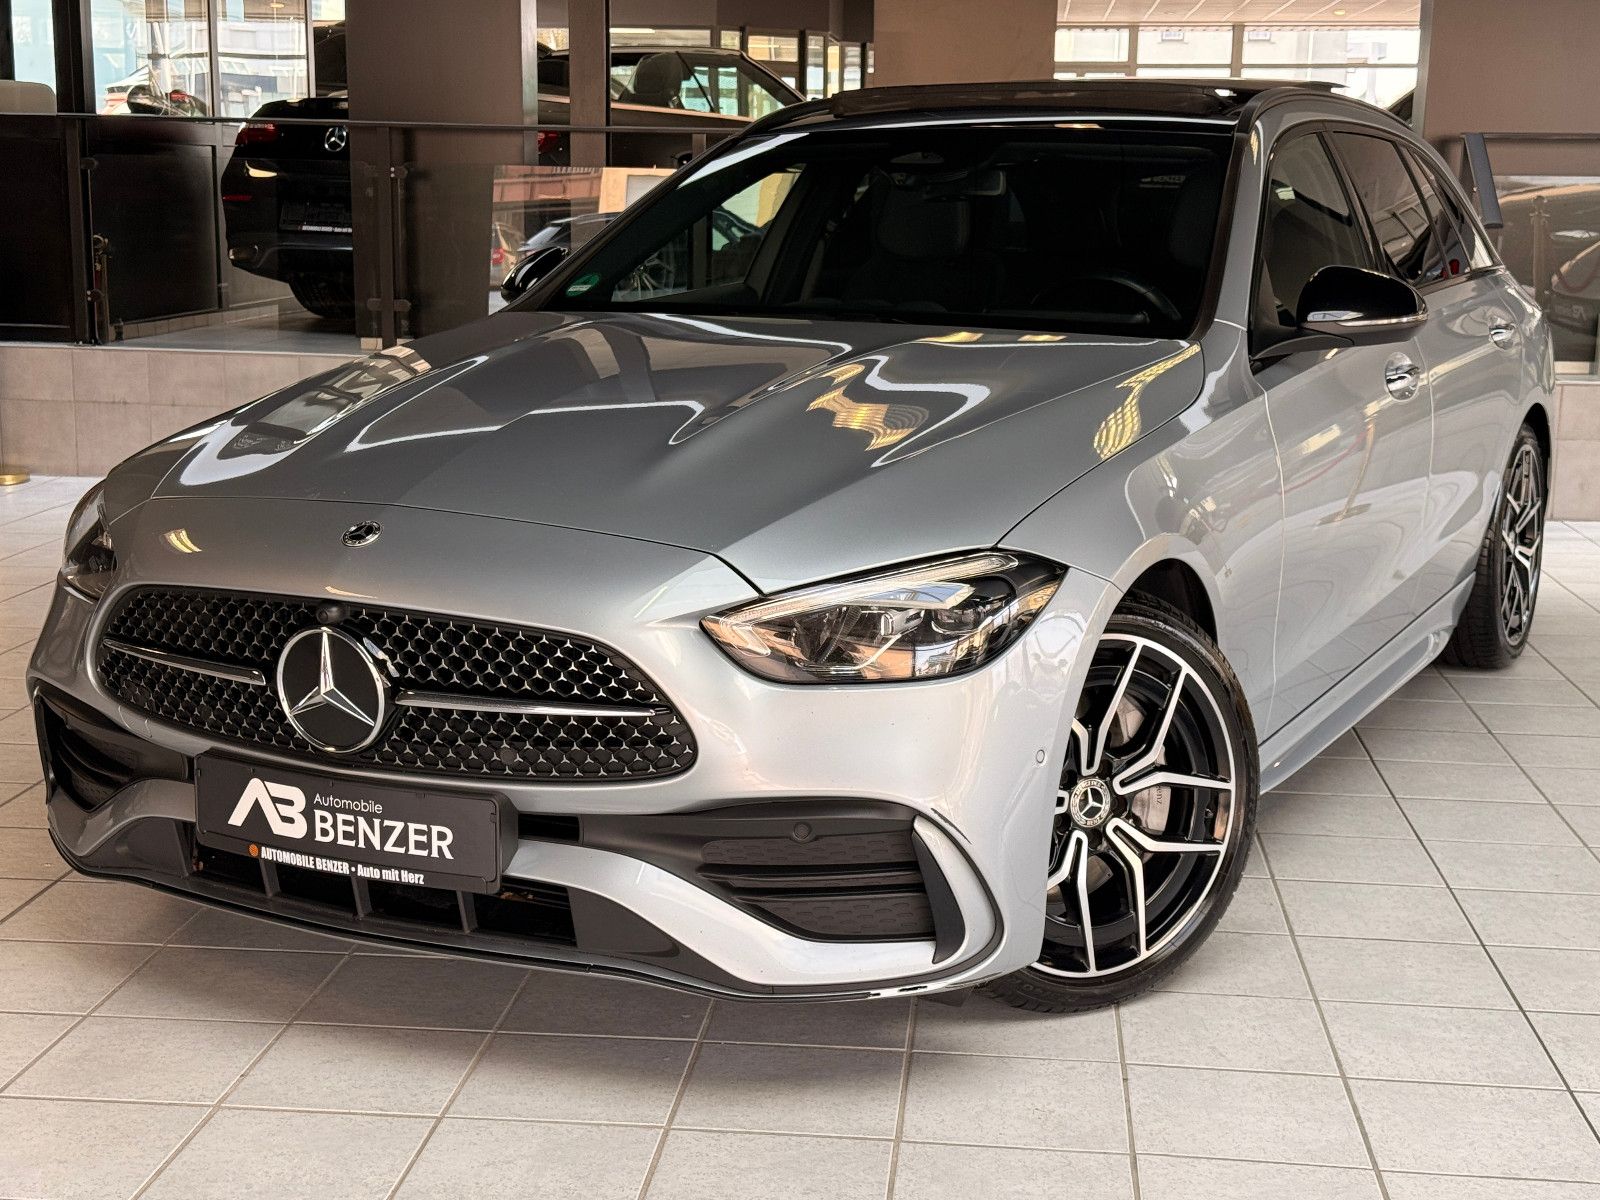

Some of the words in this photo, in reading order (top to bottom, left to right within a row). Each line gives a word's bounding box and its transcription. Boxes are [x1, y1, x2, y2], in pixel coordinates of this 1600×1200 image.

[314, 793, 383, 814] Automobile
[313, 809, 454, 859] BENZER
[260, 846, 315, 869] AUTOMOBILE
[315, 857, 350, 875] BENZER
[357, 864, 380, 880] Auto
[382, 869, 400, 882] mit
[401, 869, 425, 885] Herz
